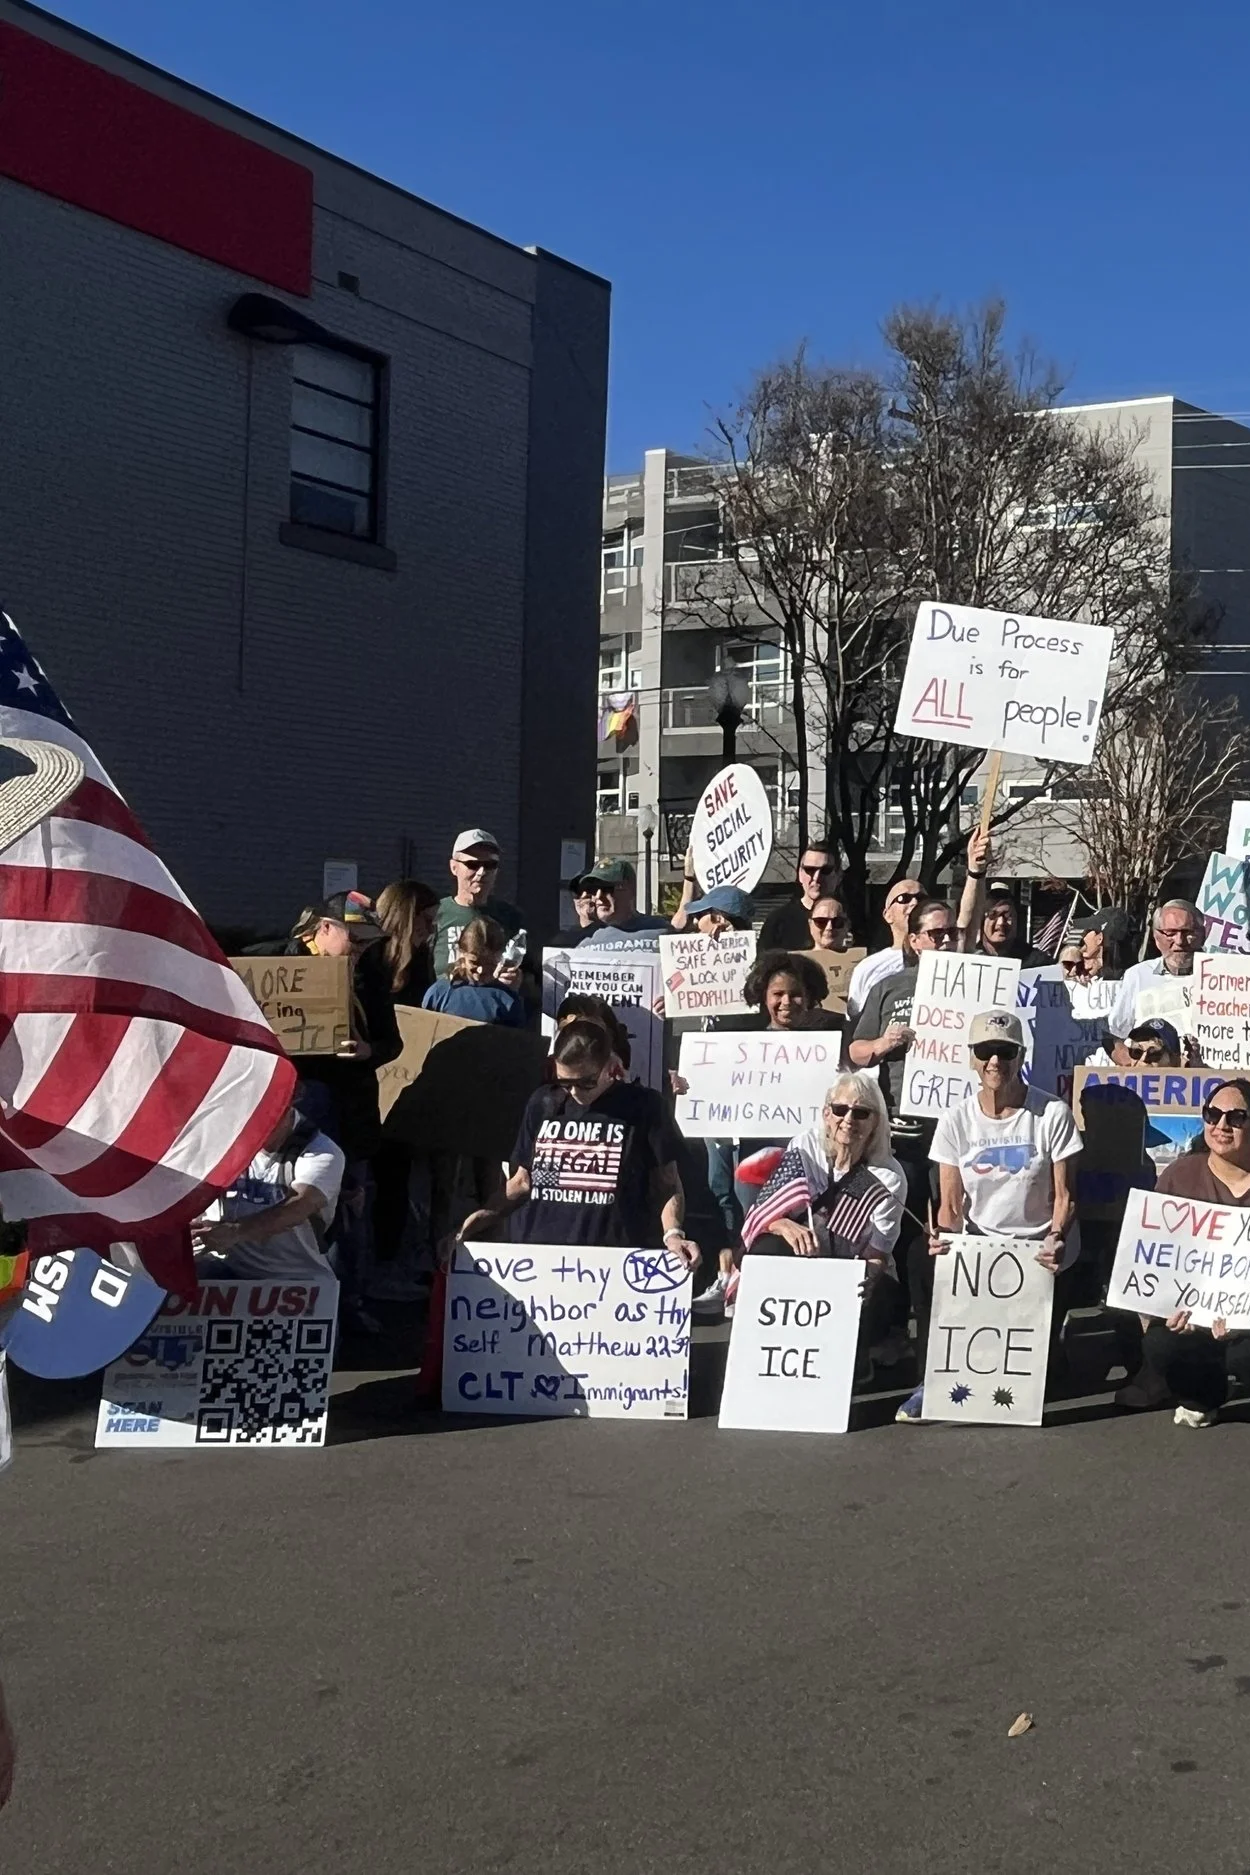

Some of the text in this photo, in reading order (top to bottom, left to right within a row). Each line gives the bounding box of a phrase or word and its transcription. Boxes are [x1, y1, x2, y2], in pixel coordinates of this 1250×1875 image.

[926, 609, 1084, 655] Due Process
[969, 656, 1030, 679] is for
[911, 677, 1098, 744] ALL people!
[704, 773, 738, 818] SAVE
[706, 802, 751, 852] SOCIAL
[706, 828, 765, 889] SECURITY
[580, 939, 660, 951] MIGRANTS
[670, 936, 750, 956] MAKE AMERICA
[676, 950, 748, 971] SAFE AGAIN
[570, 970, 635, 982] REMEMBER
[595, 982, 617, 991] YOU
[621, 984, 643, 992] CAN
[689, 970, 718, 986] LOCK
[722, 969, 737, 983] UP
[931, 959, 1013, 1007] HATE
[569, 991, 643, 1008] VENT
[916, 1004, 965, 1029] DOES
[1197, 1023, 1234, 1040] more
[693, 1041, 828, 1066] I STAND
[913, 1038, 962, 1064] MAKE
[731, 1070, 782, 1087] WITH
[910, 1070, 973, 1108] GREA
[1084, 1073, 1226, 1107] AMERIC
[686, 1099, 819, 1125] IMMIGRANT
[564, 1121, 602, 1141] ONE
[606, 1123, 625, 1143] IS
[542, 1187, 583, 1204] STOLEN
[584, 1190, 616, 1205] LAND
[451, 1248, 538, 1282] Love
[551, 1255, 612, 1302] thy
[951, 1251, 1025, 1299] NO
[1123, 1270, 1159, 1297] AS
[159, 1286, 321, 1317] OIN US!
[758, 1297, 831, 1327] STOP
[450, 1293, 691, 1338] neighbor as thy
[527, 1331, 641, 1357] Matthew
[934, 1325, 1035, 1377] ICE
[458, 1371, 524, 1401] CLT
[563, 1368, 688, 1410] Immigrants!
[105, 1418, 160, 1433] HERE
